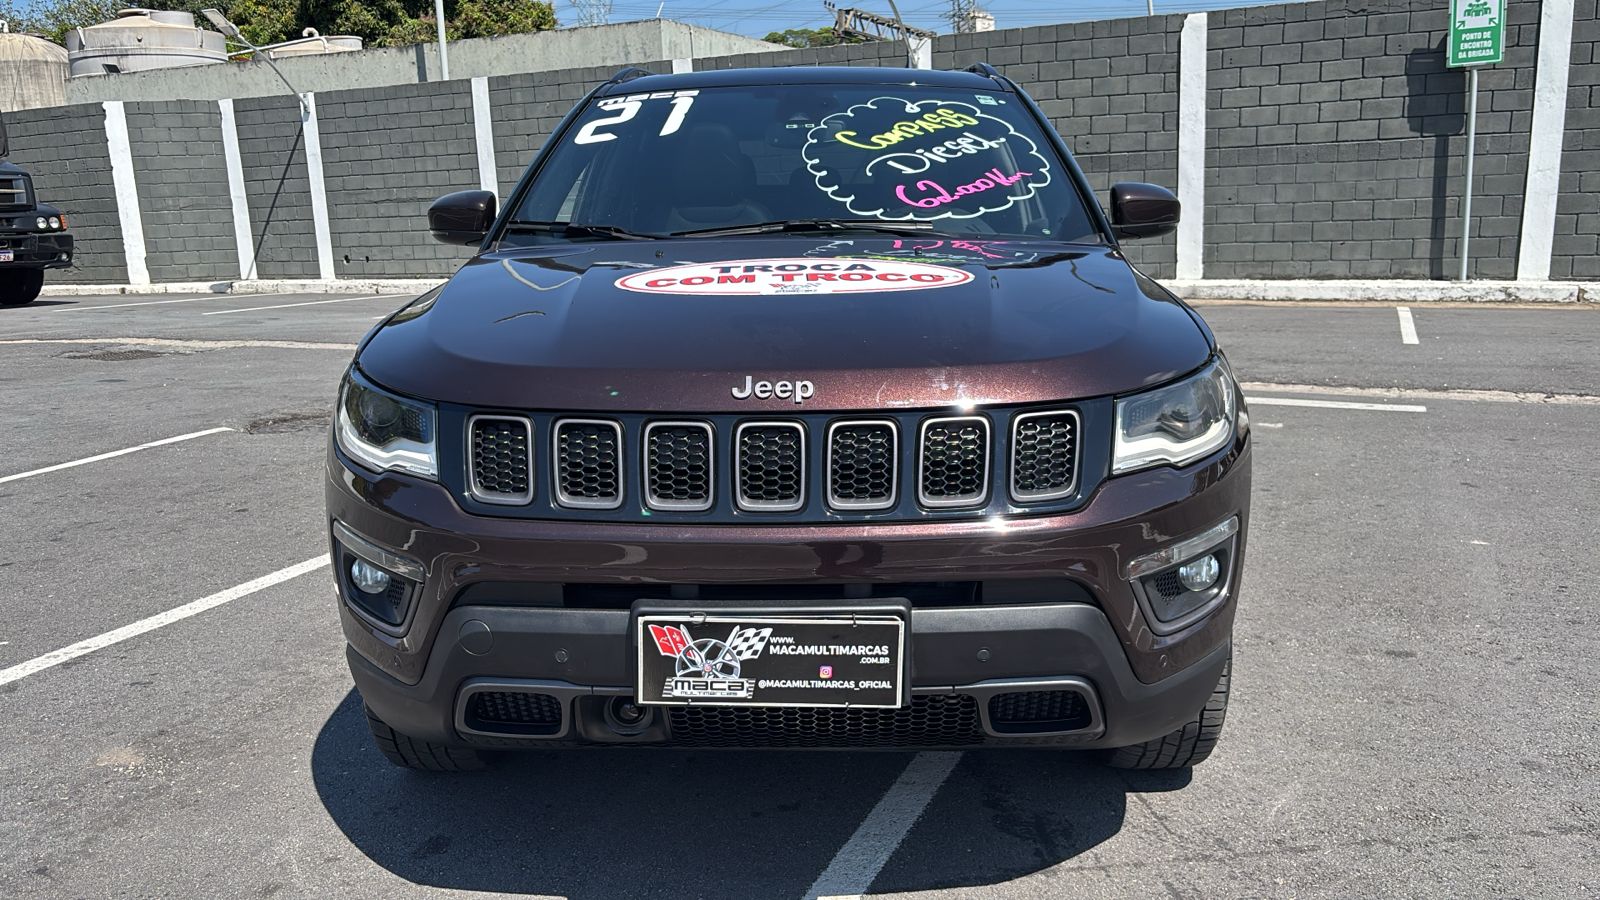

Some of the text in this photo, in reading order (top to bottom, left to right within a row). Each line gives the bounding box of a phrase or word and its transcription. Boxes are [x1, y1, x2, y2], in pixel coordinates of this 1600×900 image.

[1461, 32, 1482, 40] PONTO
[1460, 40, 1492, 49] ENCONTRO
[574, 97, 694, 144] 21
[711, 264, 876, 274] TROCA
[646, 273, 944, 288] COM TROCO
[732, 376, 814, 404] Jeep
[769, 645, 889, 656] MACAMULTIMARCAS
[758, 680, 892, 690] @MACAMULTIMARCAS_OFICIAL
